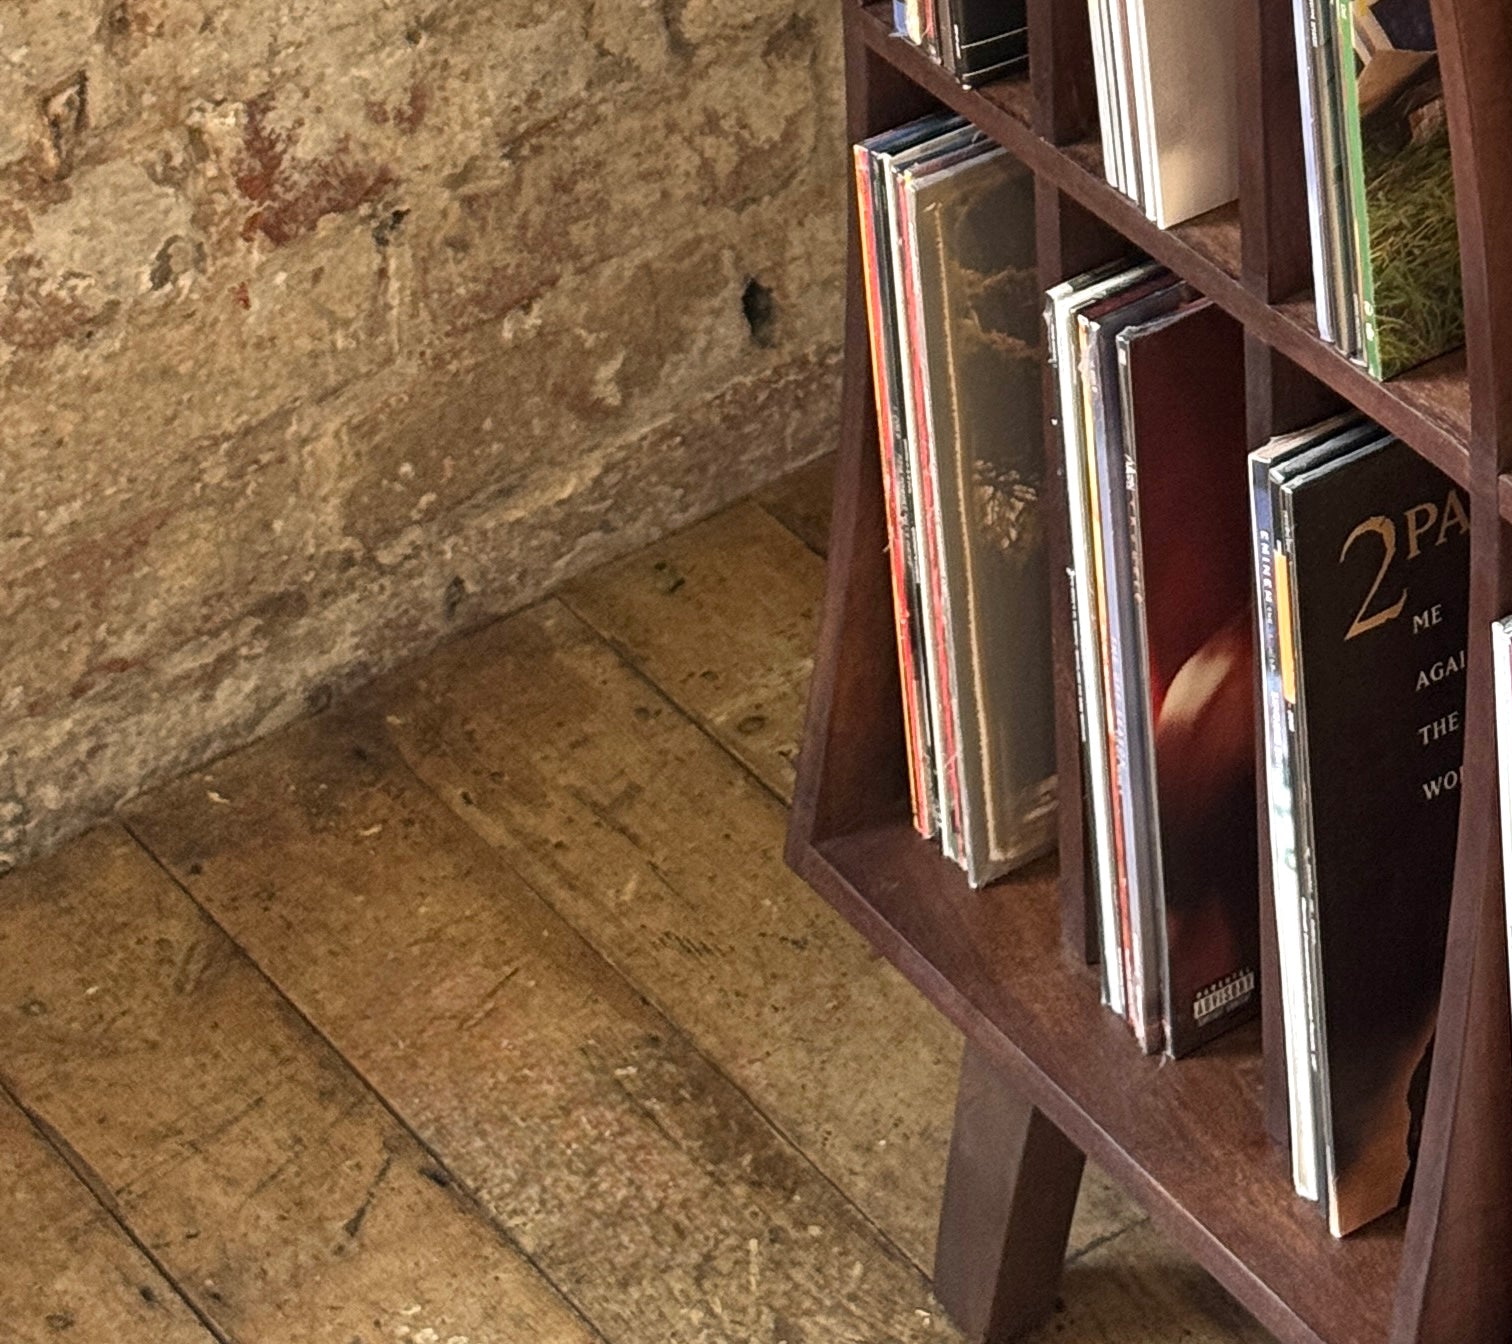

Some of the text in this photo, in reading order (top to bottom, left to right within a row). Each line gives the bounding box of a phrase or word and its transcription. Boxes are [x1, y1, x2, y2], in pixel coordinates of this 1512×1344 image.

[1339, 489, 1471, 641] 2PA
[1413, 604, 1443, 635] ME
[1415, 650, 1467, 692] AGAI
[1418, 711, 1460, 746] THE
[1421, 765, 1464, 801] WO
